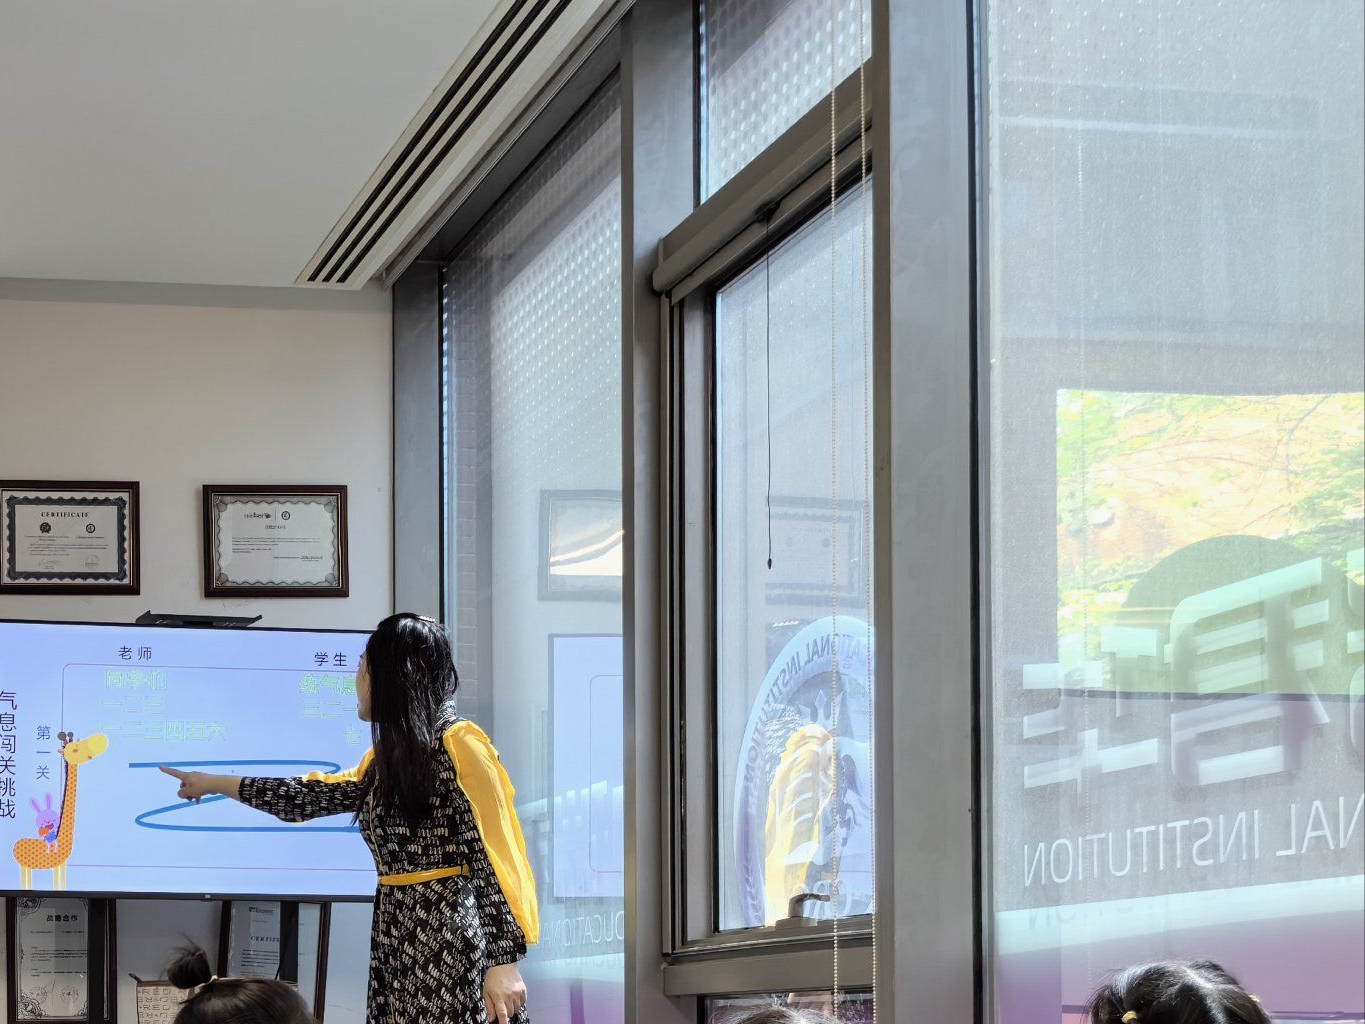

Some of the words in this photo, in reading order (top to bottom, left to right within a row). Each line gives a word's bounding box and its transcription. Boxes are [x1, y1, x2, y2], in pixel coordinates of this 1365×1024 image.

[118, 645, 153, 661] 老师
[314, 652, 348, 667] 学生
[105, 669, 168, 691] 同学们
[101, 721, 227, 743] 一二三四五六
[35, 725, 51, 781] 第一关
